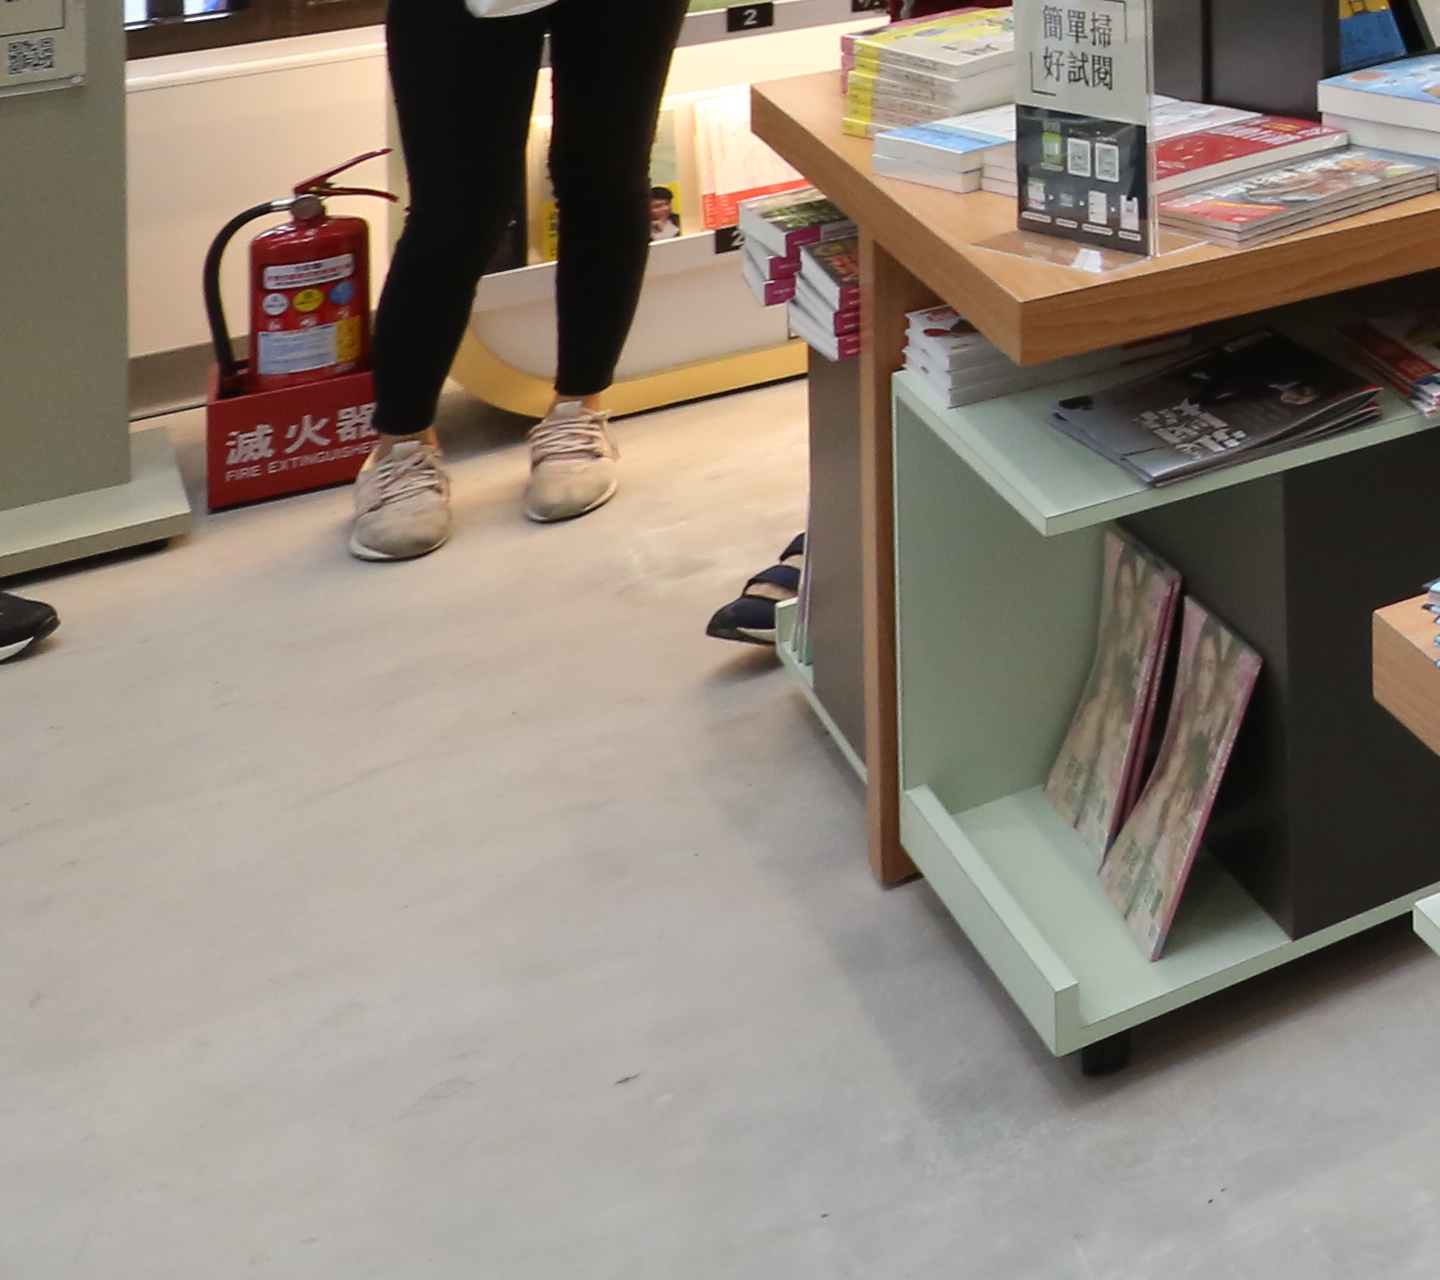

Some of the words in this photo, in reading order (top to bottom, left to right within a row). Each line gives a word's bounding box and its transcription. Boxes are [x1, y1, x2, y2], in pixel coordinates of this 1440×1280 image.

[743, 8, 758, 26] 2
[1042, 4, 1113, 48] 簡單掃
[1042, 46, 1114, 91] 好試閱
[225, 401, 377, 468] 滅火器
[225, 462, 262, 483] FIRE
